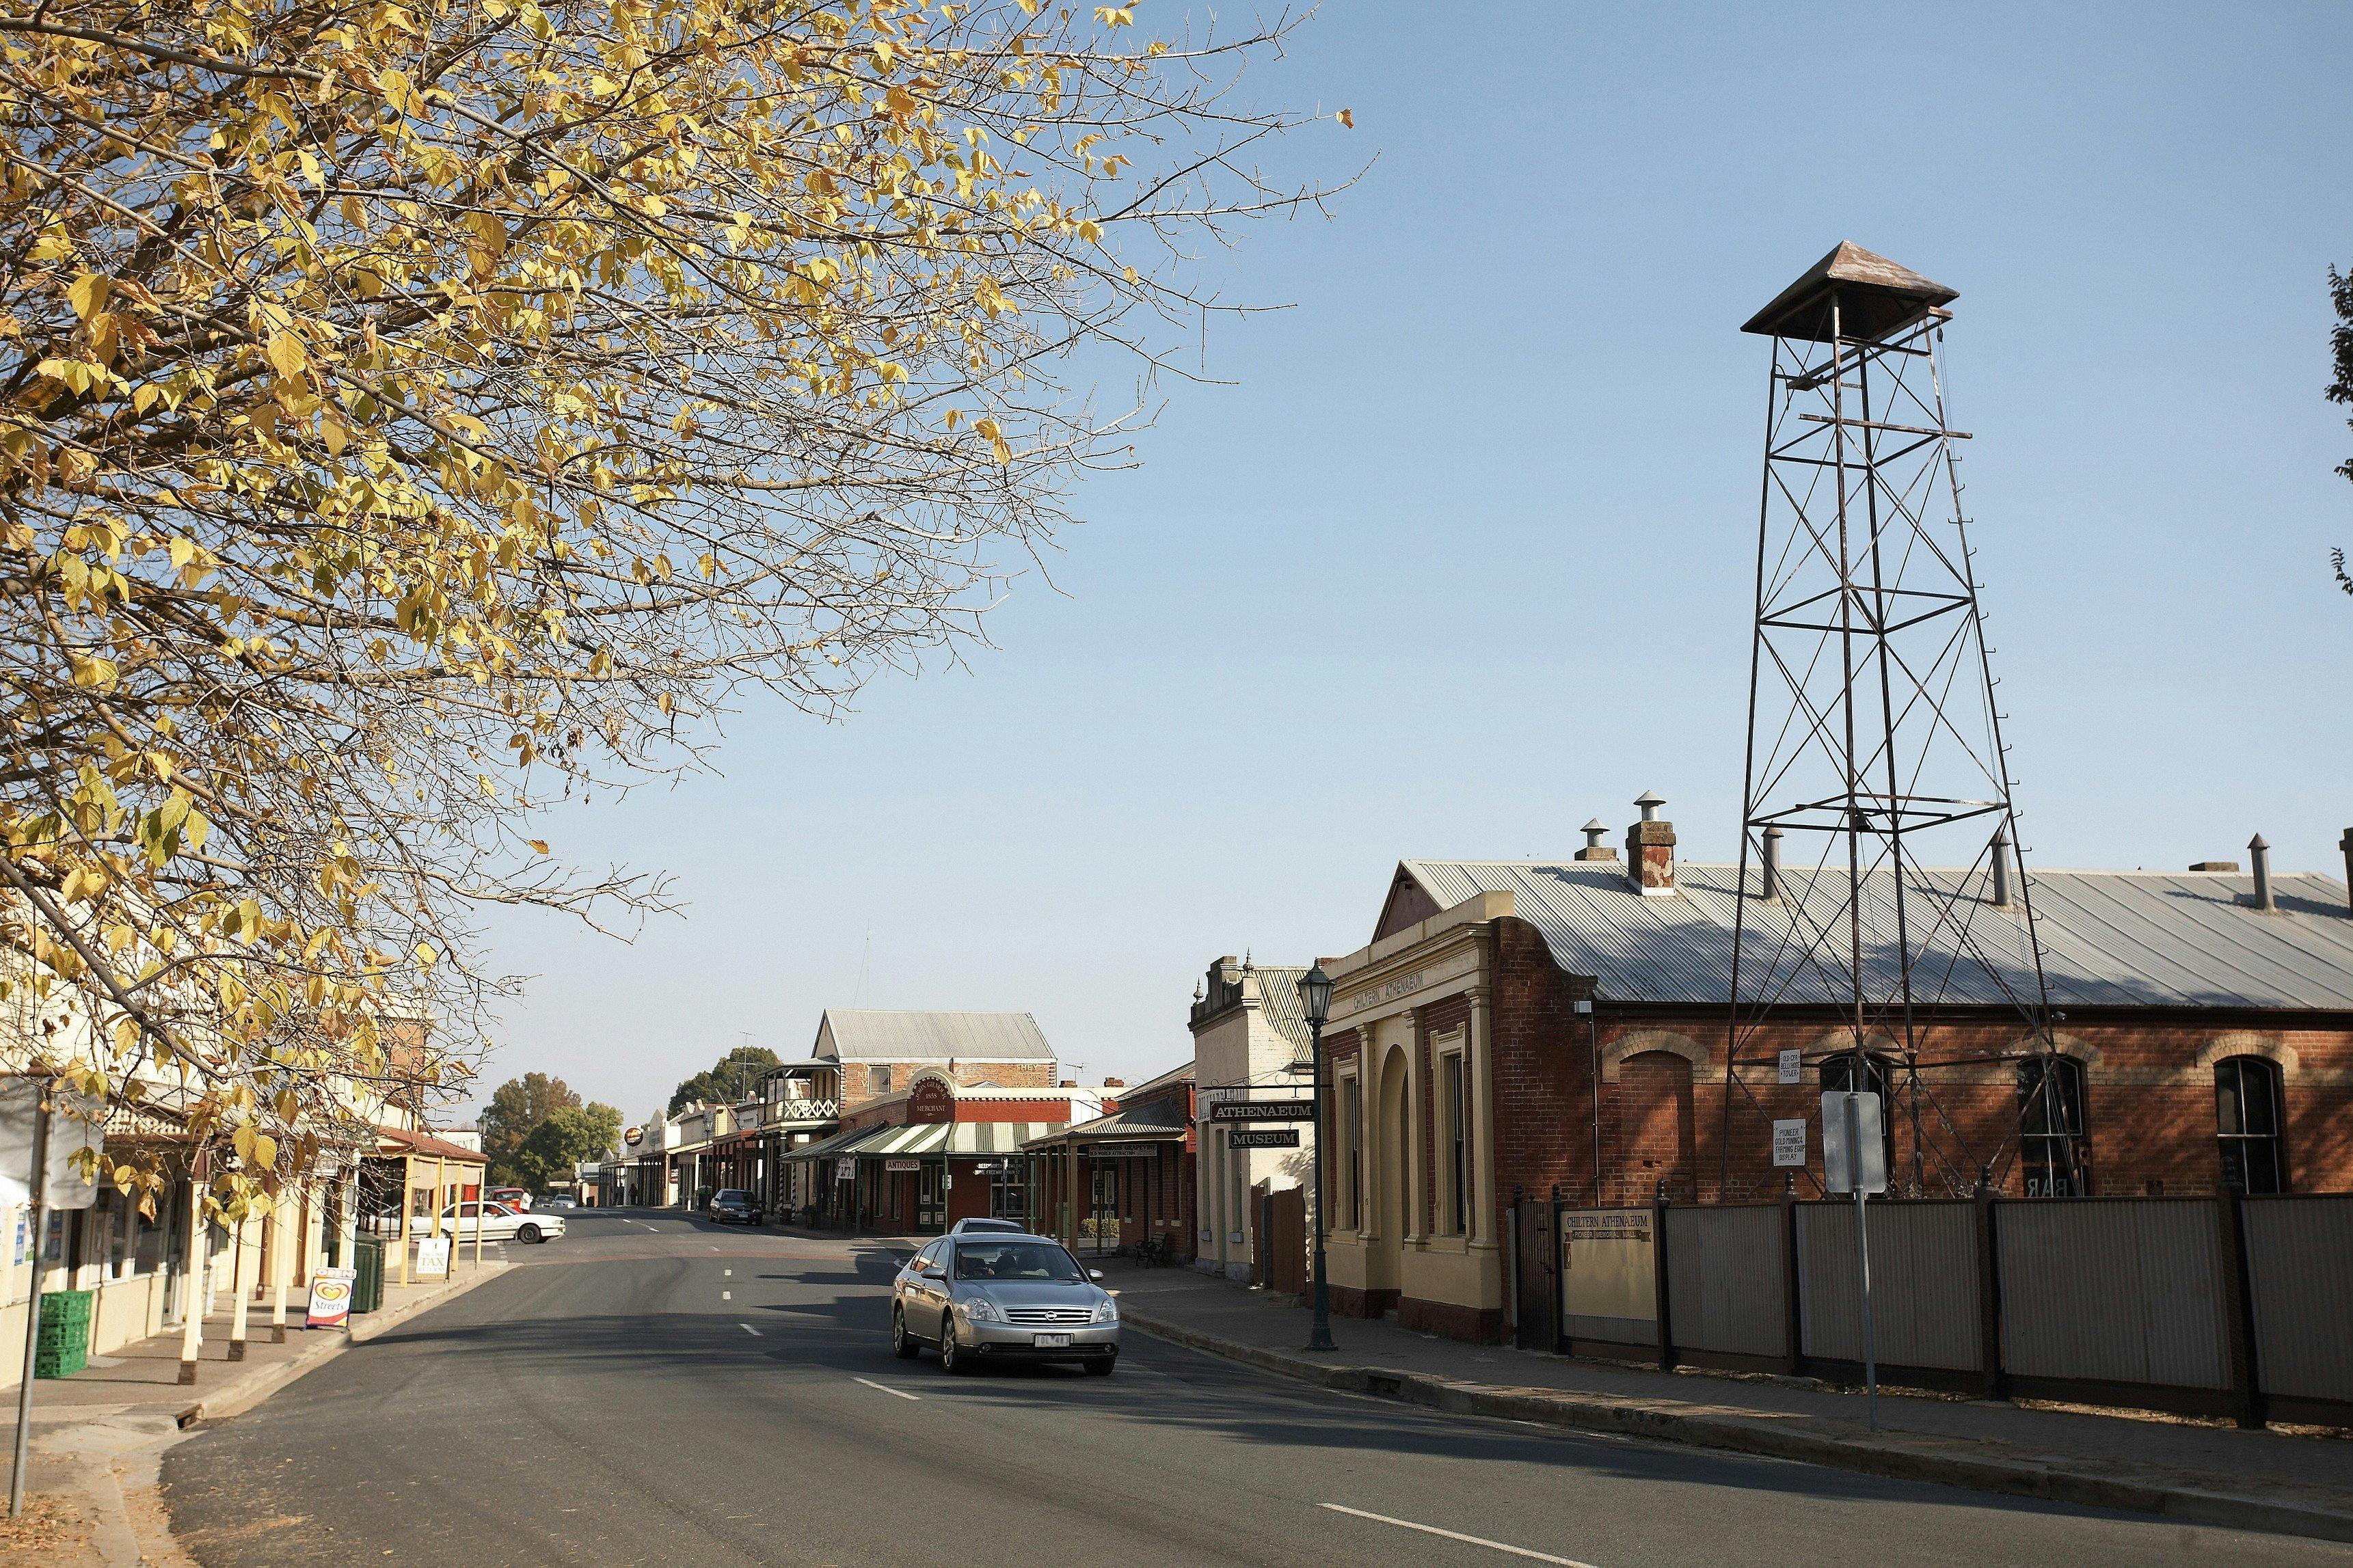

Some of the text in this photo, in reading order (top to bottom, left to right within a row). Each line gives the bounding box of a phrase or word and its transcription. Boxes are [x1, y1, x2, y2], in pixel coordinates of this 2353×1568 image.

[1354, 971, 1424, 1010] CHILTERN ATHENAEUM
[916, 1084, 927, 1100] JOHN
[1215, 1105, 1312, 1118] ATHENAEUM
[1233, 1133, 1295, 1145] MUSEUM
[888, 1161, 918, 1170] ANTIQUES
[1567, 1215, 1648, 1227] CHILTERN ATHENAEUM
[420, 1258, 445, 1266] TAX
[314, 1300, 345, 1310] Streets
